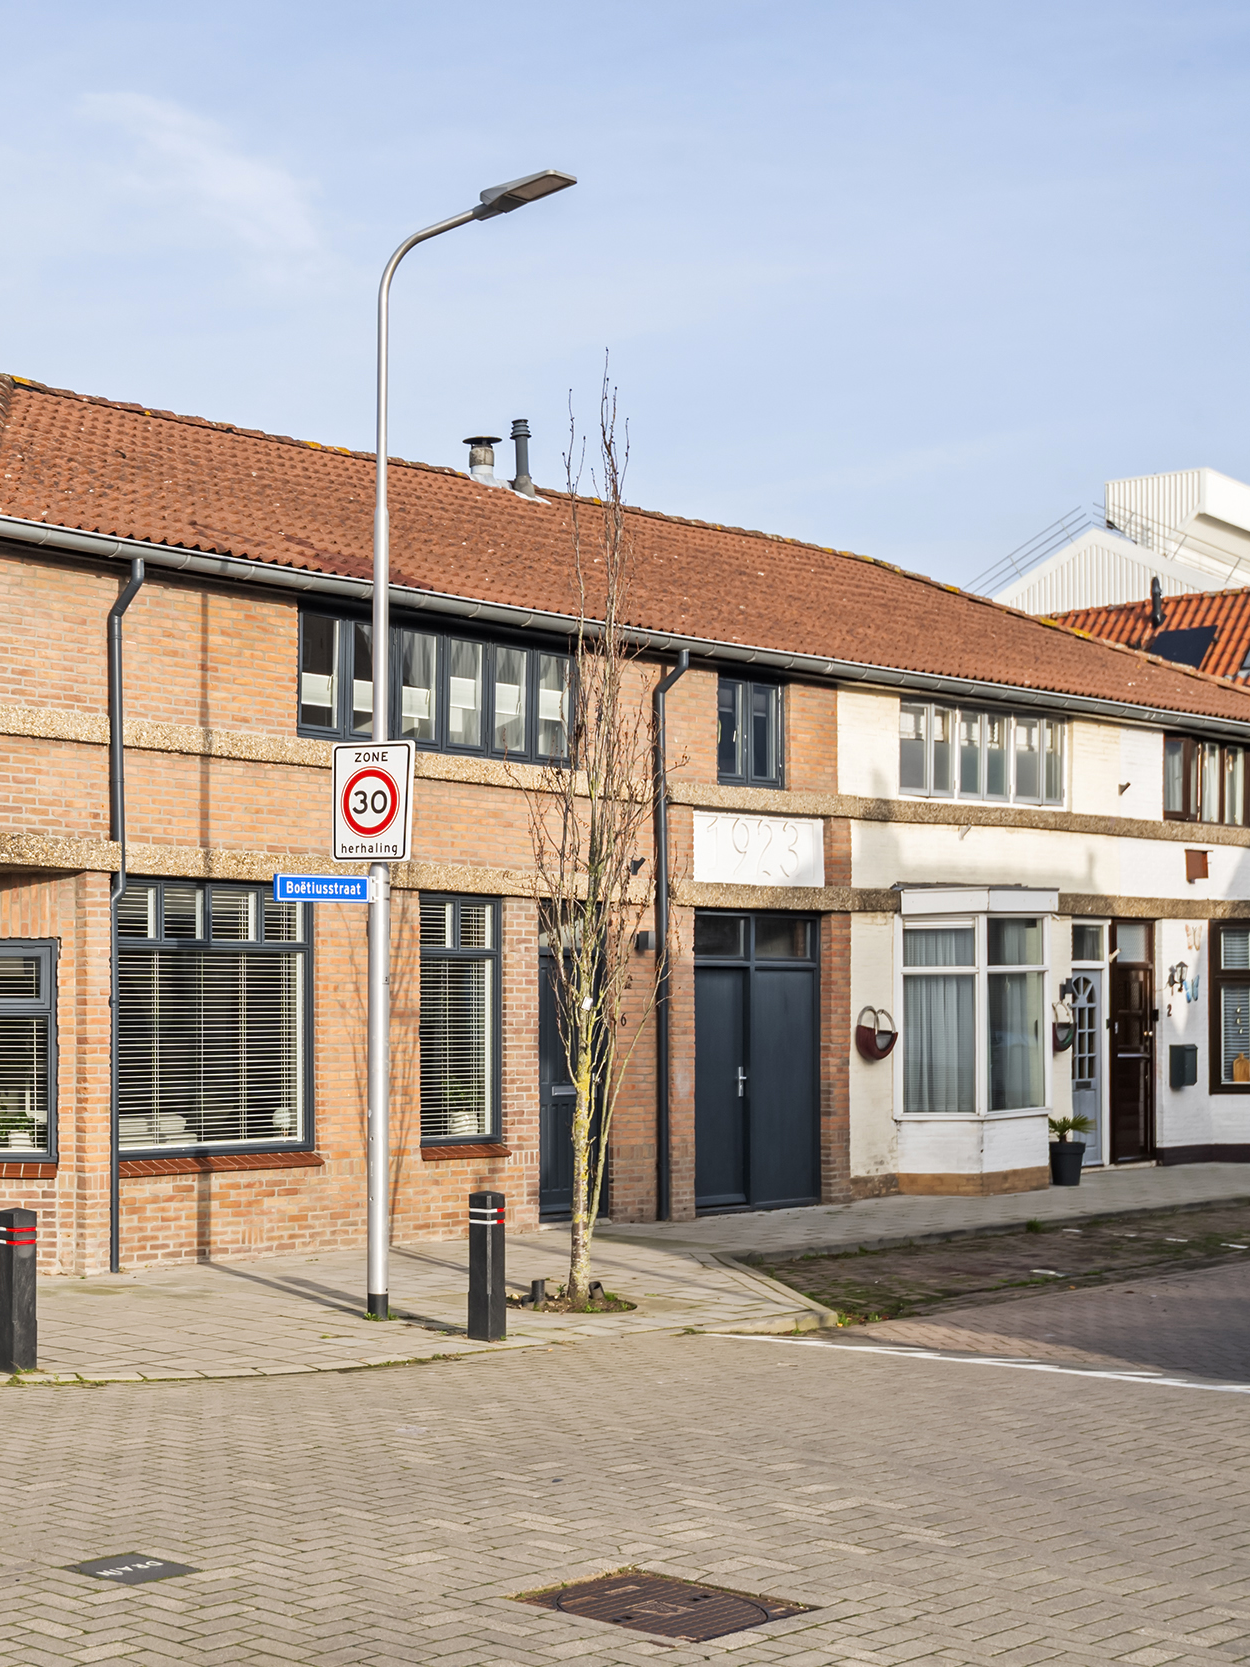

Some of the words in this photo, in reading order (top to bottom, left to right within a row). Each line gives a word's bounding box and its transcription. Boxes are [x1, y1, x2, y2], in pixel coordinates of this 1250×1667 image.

[354, 751, 389, 763] ZONE
[352, 790, 388, 815] 30
[341, 843, 398, 856] herhaling
[707, 817, 799, 877] 1923
[286, 881, 361, 895] Boëtiusstraat
[1167, 1003, 1172, 1017] 2
[620, 1012, 627, 1027] 6
[95, 1560, 164, 1577] DRAIN
